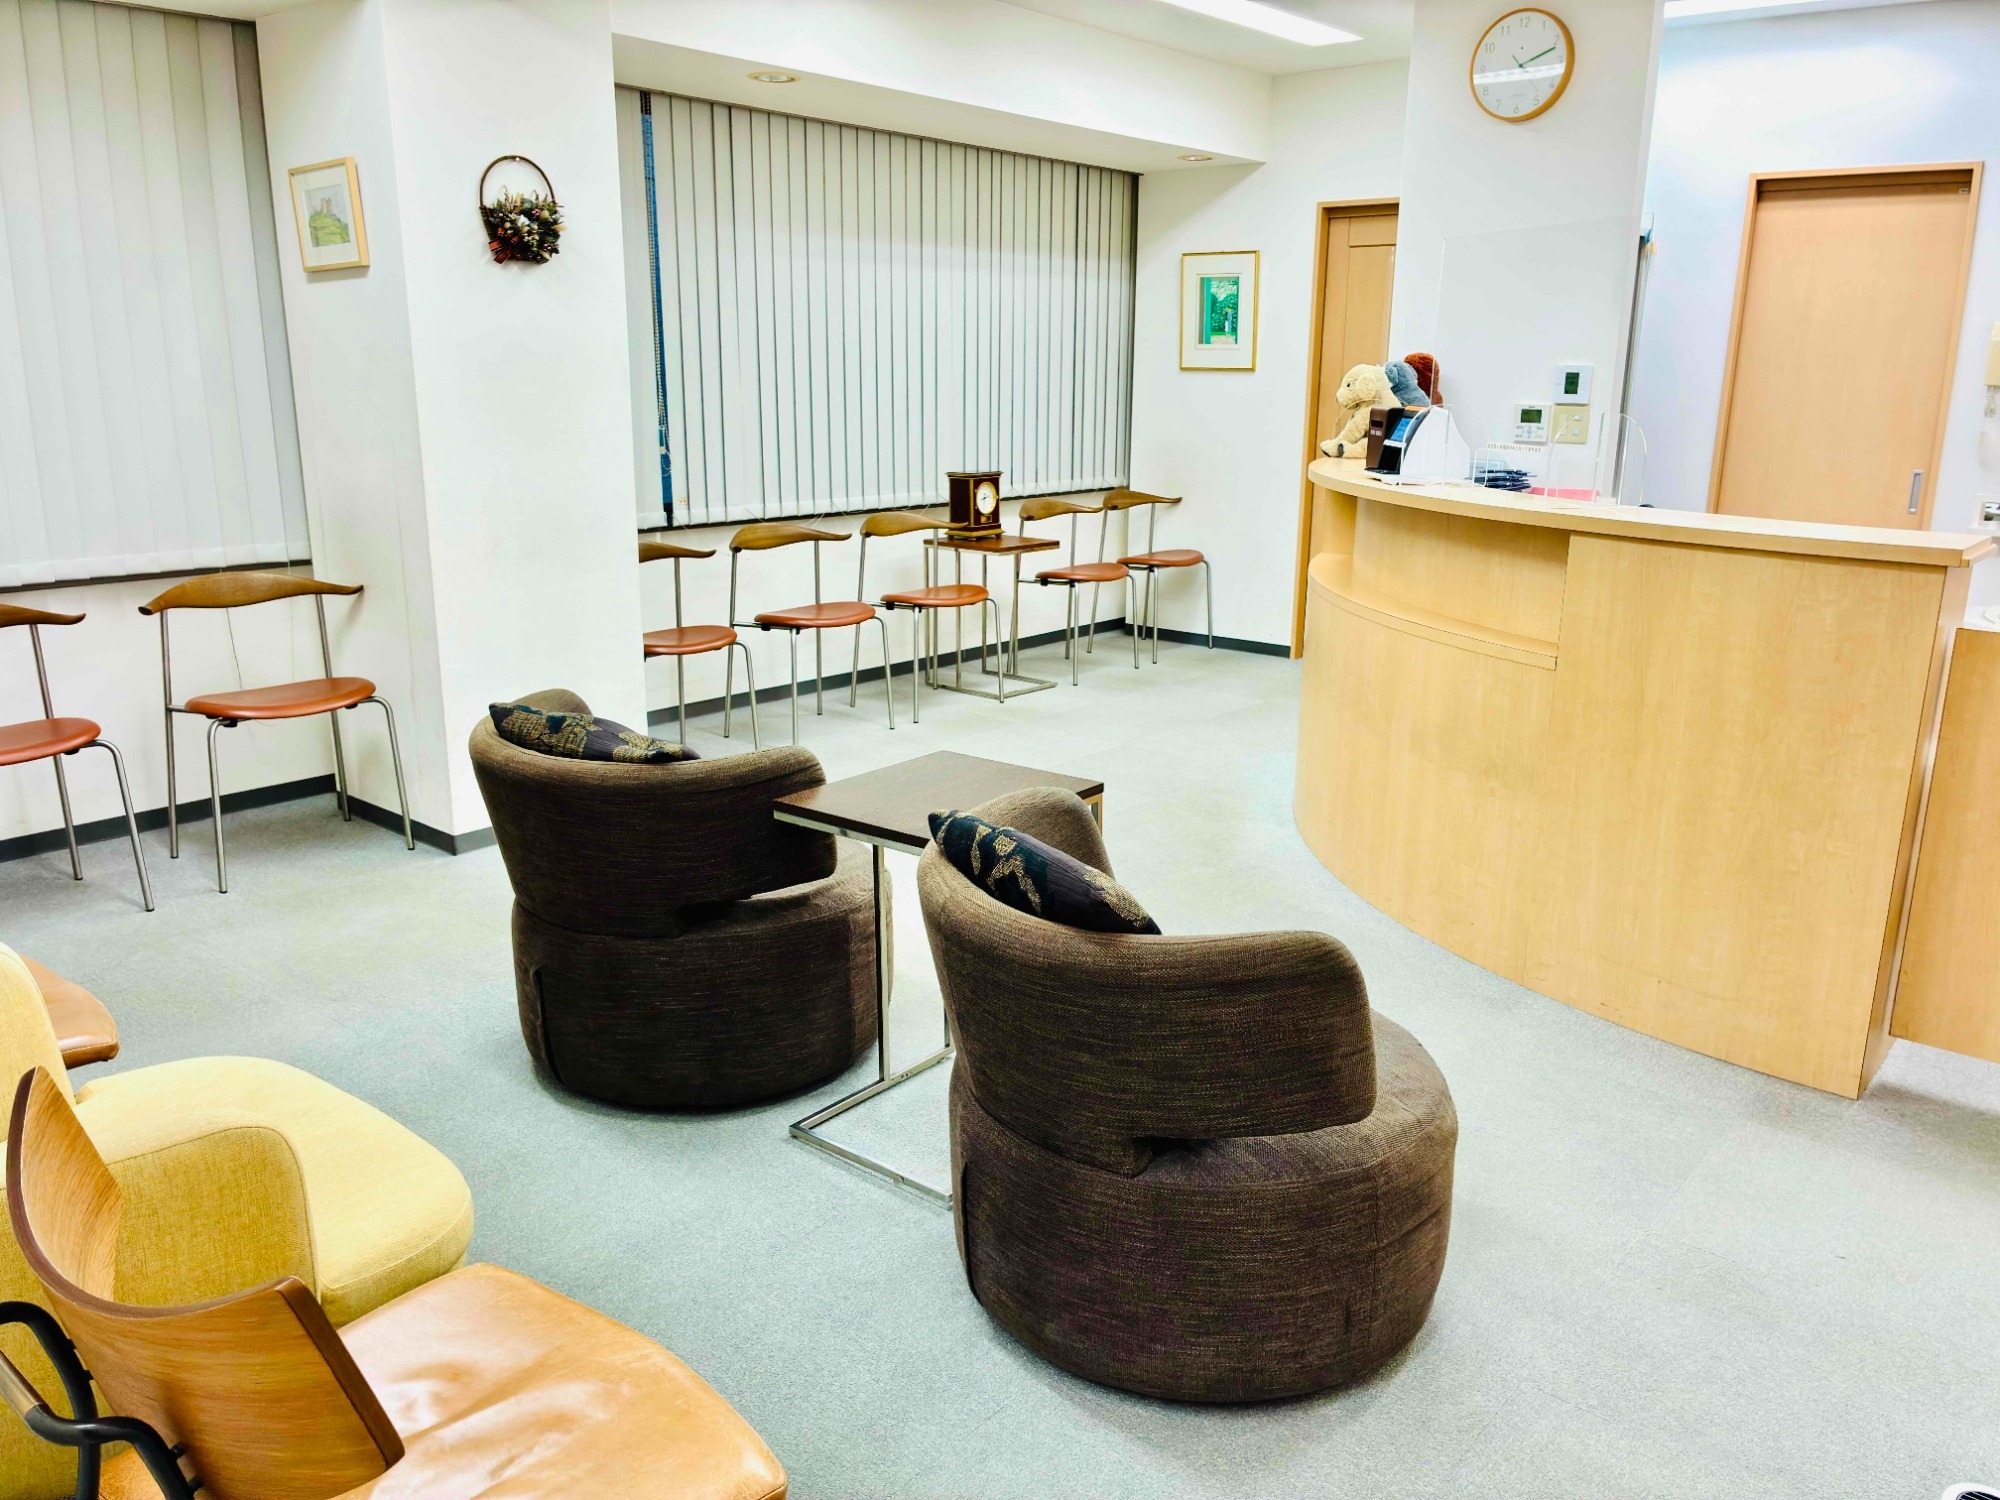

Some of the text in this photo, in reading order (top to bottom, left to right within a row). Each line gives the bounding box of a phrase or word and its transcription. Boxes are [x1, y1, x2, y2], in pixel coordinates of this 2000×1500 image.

[1520, 17, 1530, 27] 12
[1501, 25, 1510, 36] 11
[1554, 34, 1560, 45] 2
[1485, 42, 1495, 53] 10
[1483, 86, 1488, 96] 8
[1496, 99, 1501, 110] 7
[1533, 95, 1539, 106] 5
[1514, 103, 1519, 113] 6
